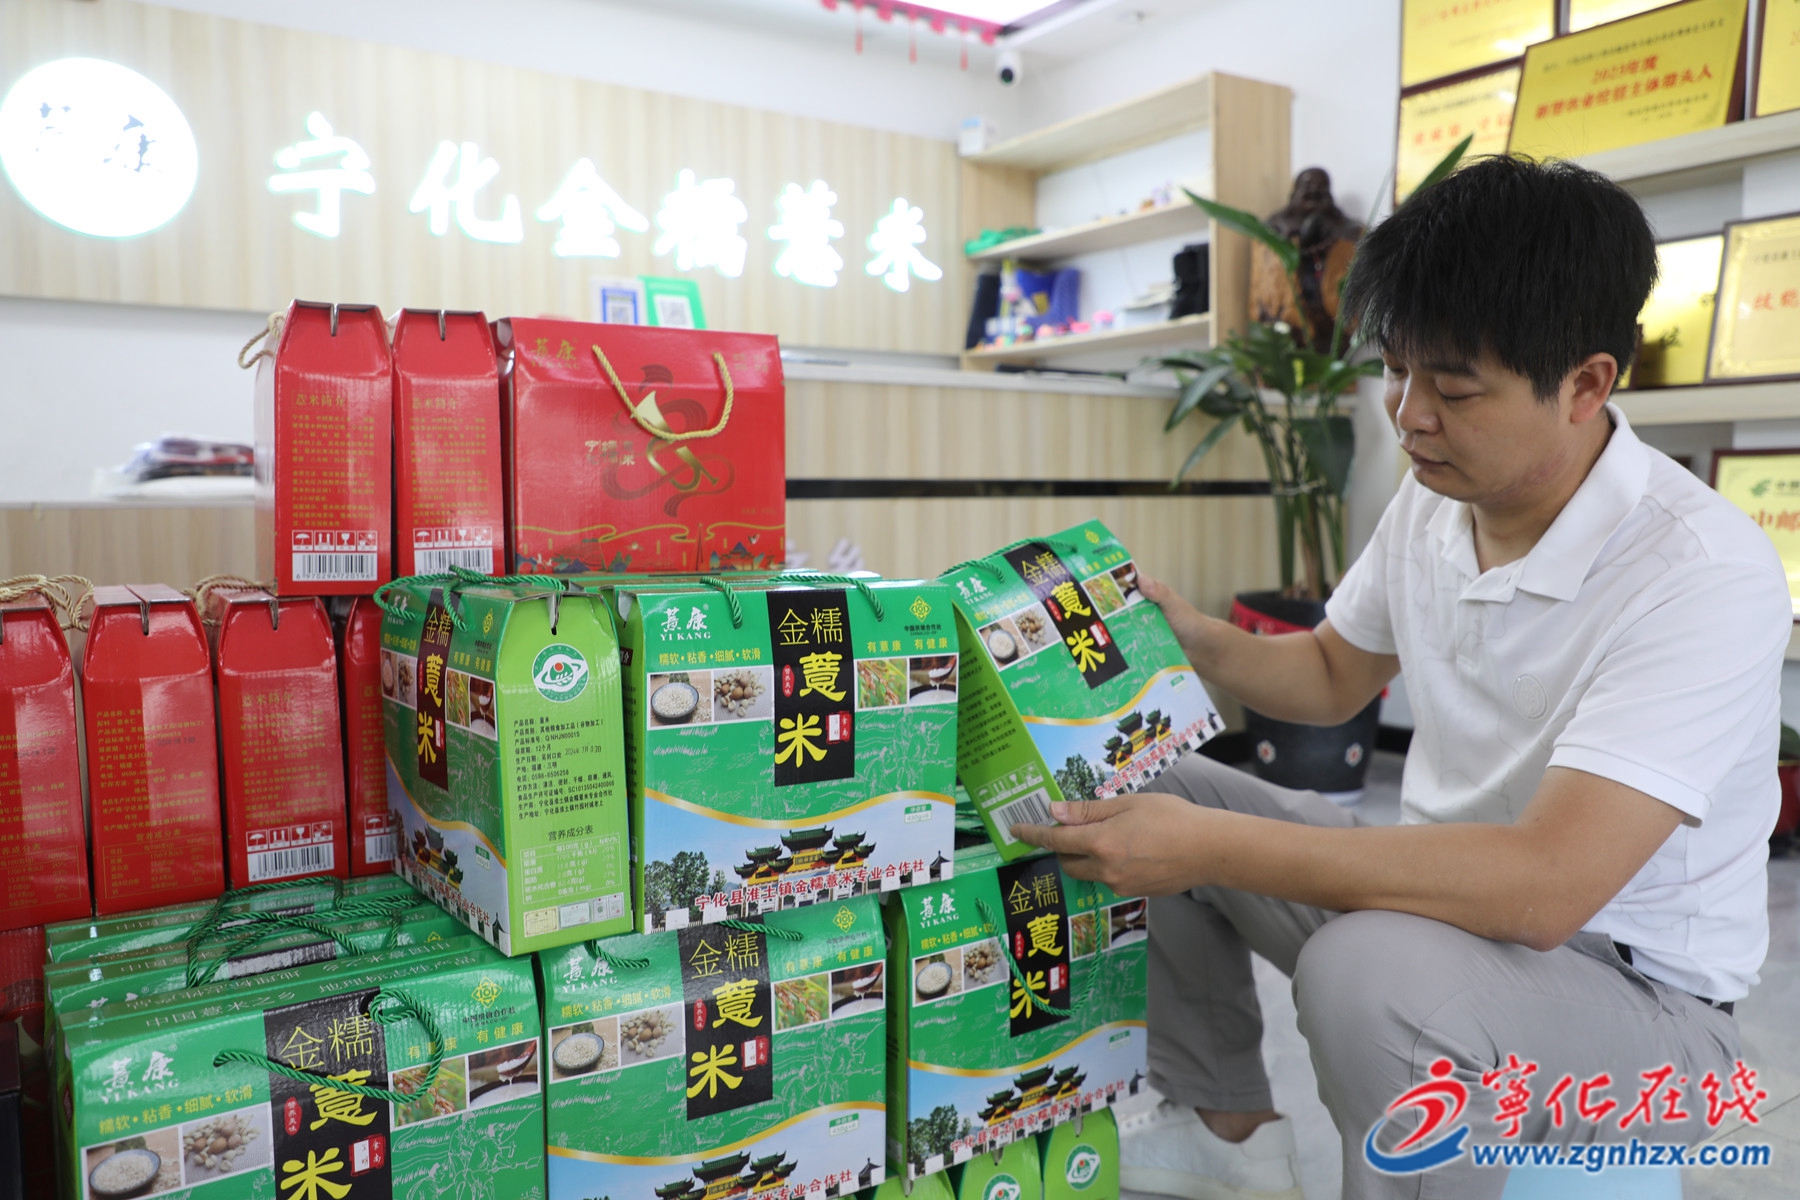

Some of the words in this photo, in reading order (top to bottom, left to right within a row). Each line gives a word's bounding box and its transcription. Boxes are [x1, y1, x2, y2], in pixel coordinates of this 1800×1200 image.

[661, 606, 708, 633] 薏康
[777, 607, 844, 646] 金糯
[775, 651, 847, 768] 薏米
[548, 825, 593, 841] 营养成分表
[695, 859, 925, 911] 宁化县淮土镇金糯薏米专业合作社
[920, 892, 956, 920] 薏康
[1008, 872, 1059, 915] 金糯
[688, 931, 760, 981] 金糯
[279, 1012, 374, 1072] 金糯
[476, 1022, 524, 1043] 有健康
[686, 977, 763, 1100] 薏米
[102, 1051, 175, 1092] 薏康
[99, 1084, 253, 1135] 糯软·粘香·细腻·软滑
[747, 1169, 852, 1200] 米专业合作社
